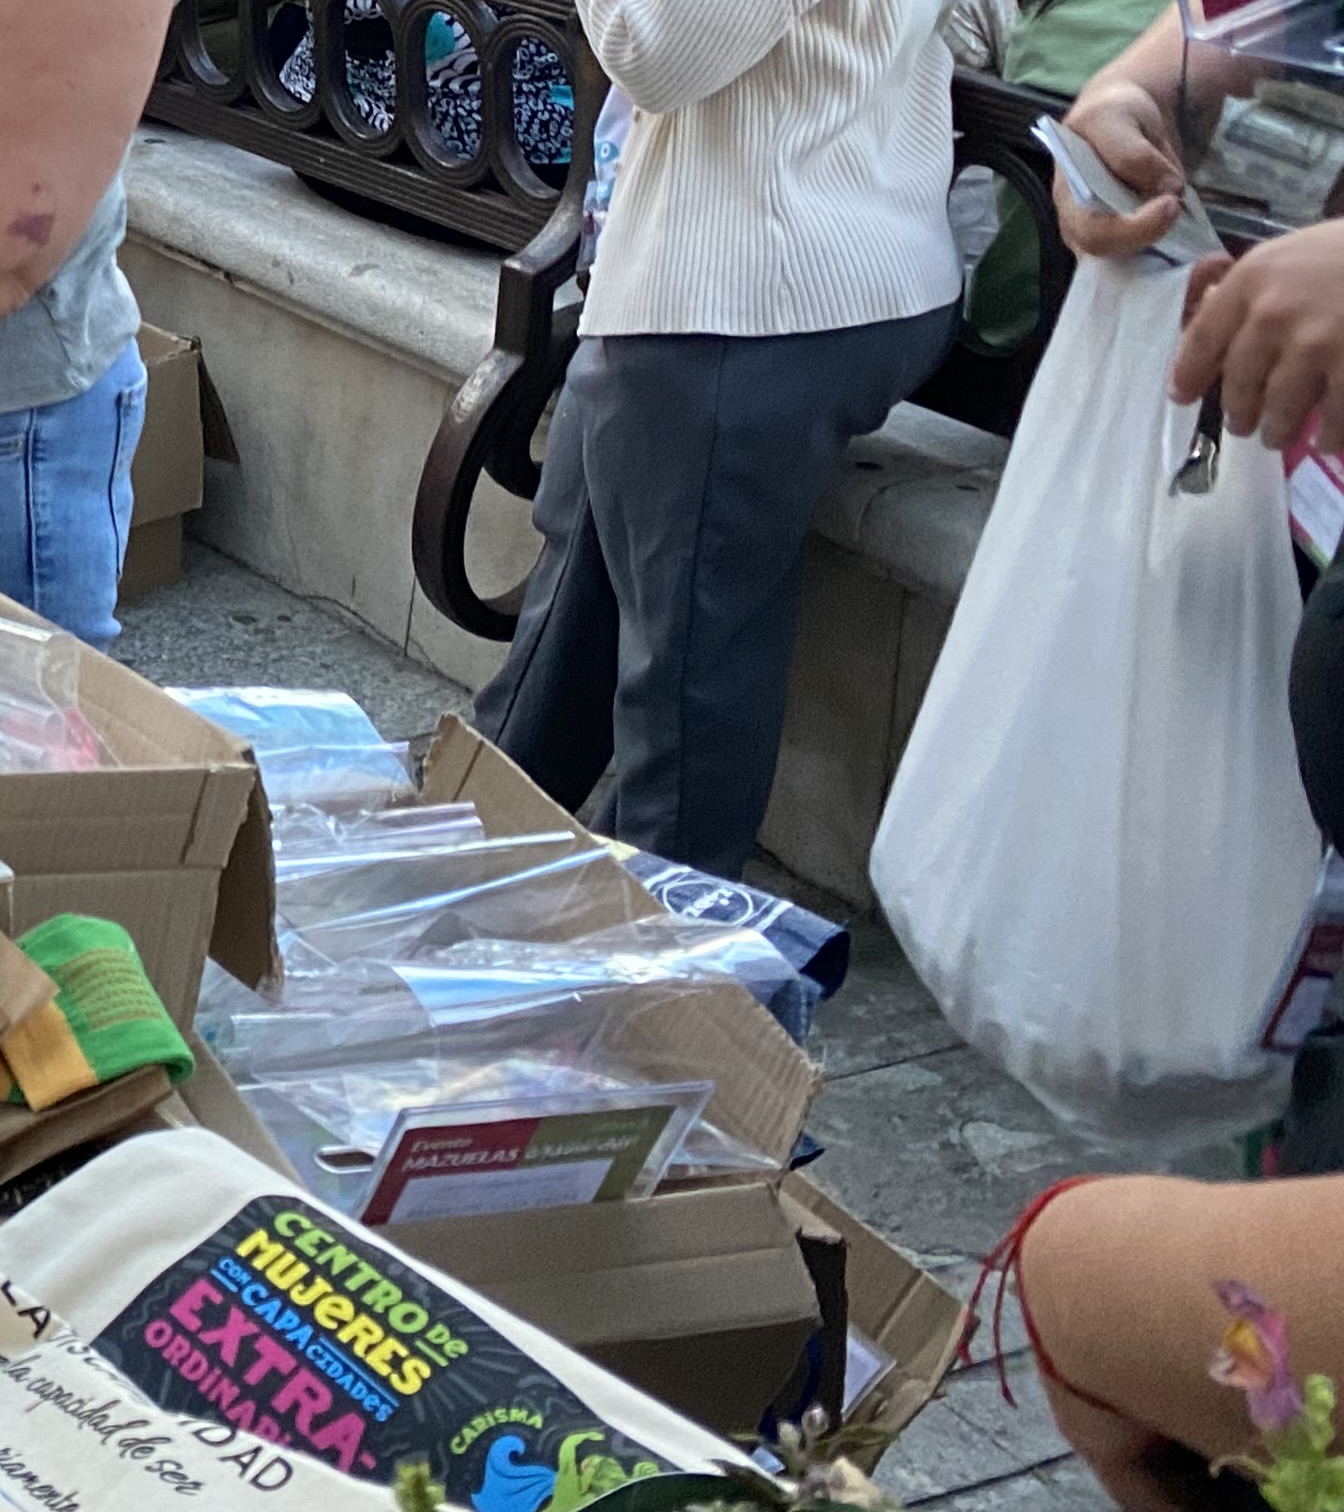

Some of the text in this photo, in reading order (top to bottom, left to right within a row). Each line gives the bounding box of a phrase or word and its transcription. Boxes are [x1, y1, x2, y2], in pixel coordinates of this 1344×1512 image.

[402, 1148, 520, 1172] MAZUELAS
[411, 1138, 475, 1154] Evento
[273, 1209, 430, 1334] CENTRO
[144, 1458, 208, 1496] ser
